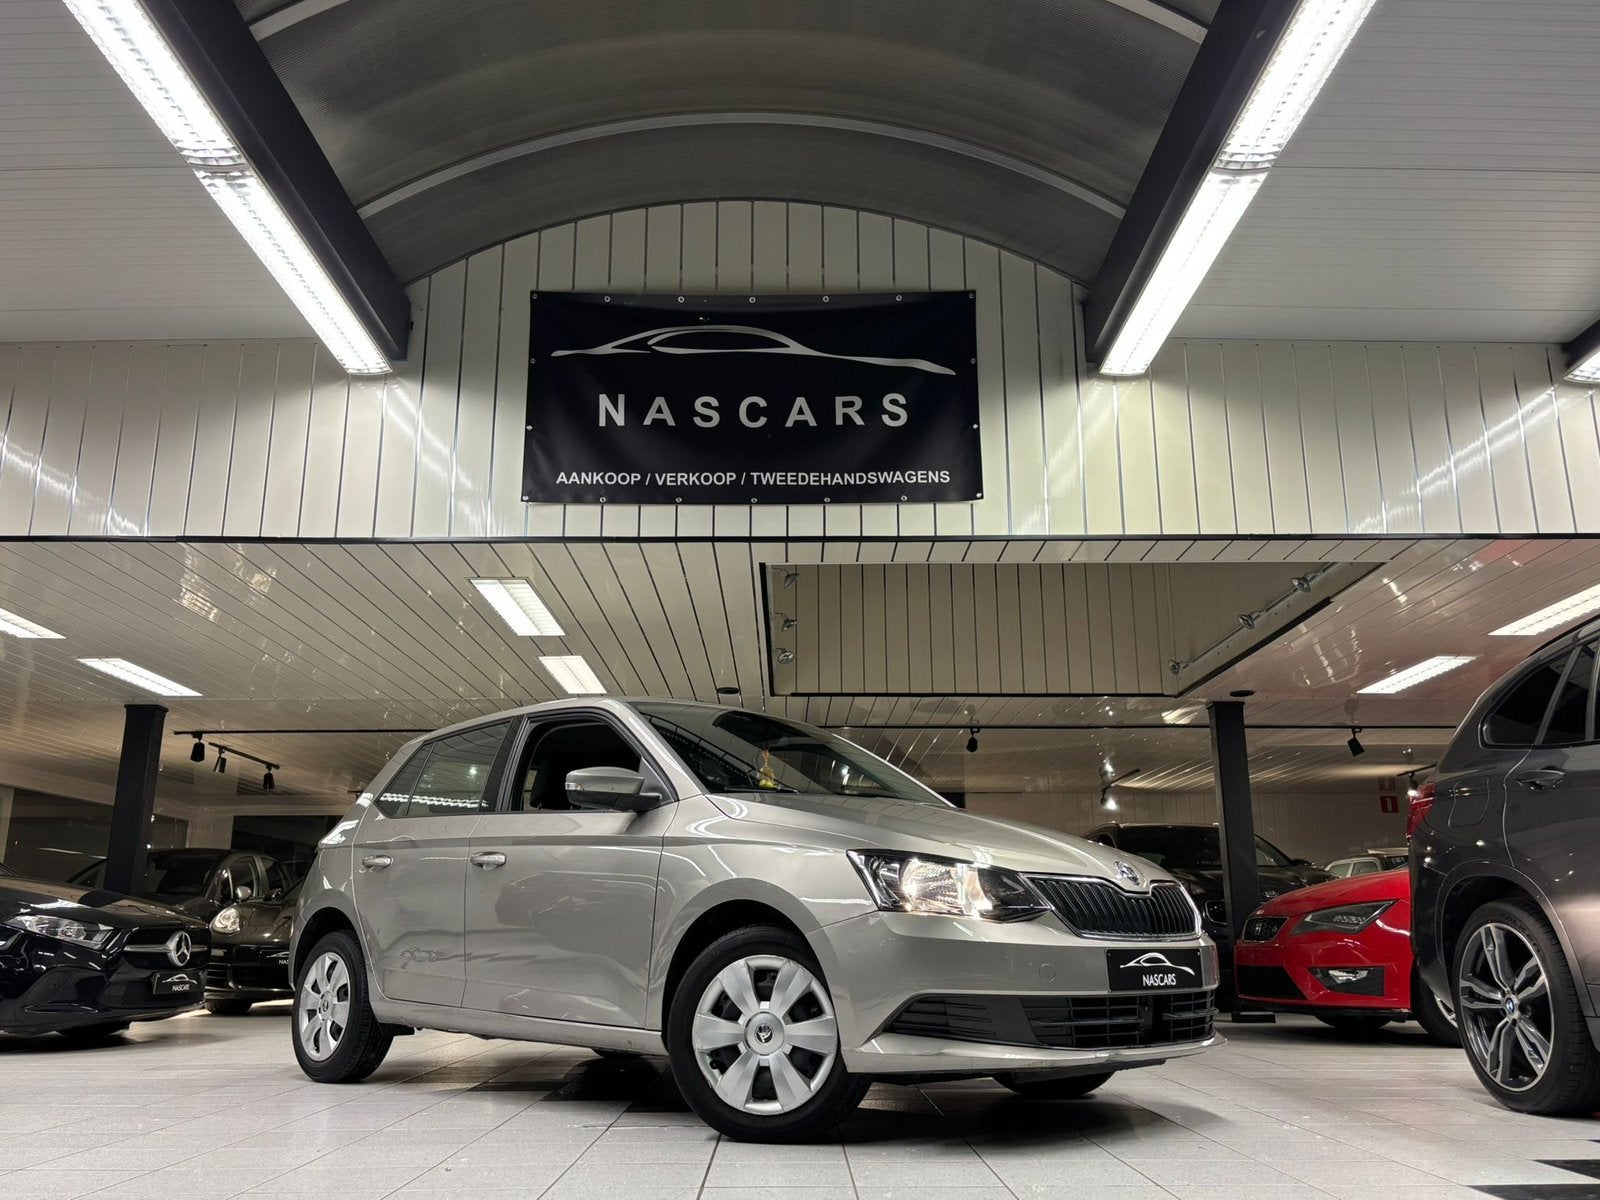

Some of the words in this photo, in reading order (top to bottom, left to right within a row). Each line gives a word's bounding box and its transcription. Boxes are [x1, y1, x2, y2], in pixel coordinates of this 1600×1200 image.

[598, 393, 908, 427] NASCARS
[555, 472, 641, 485] AANKOOP
[654, 472, 737, 486] VERKOOP
[750, 470, 951, 486] TWEEDEHANDSWAGENS
[1142, 973, 1177, 986] NASCARS
